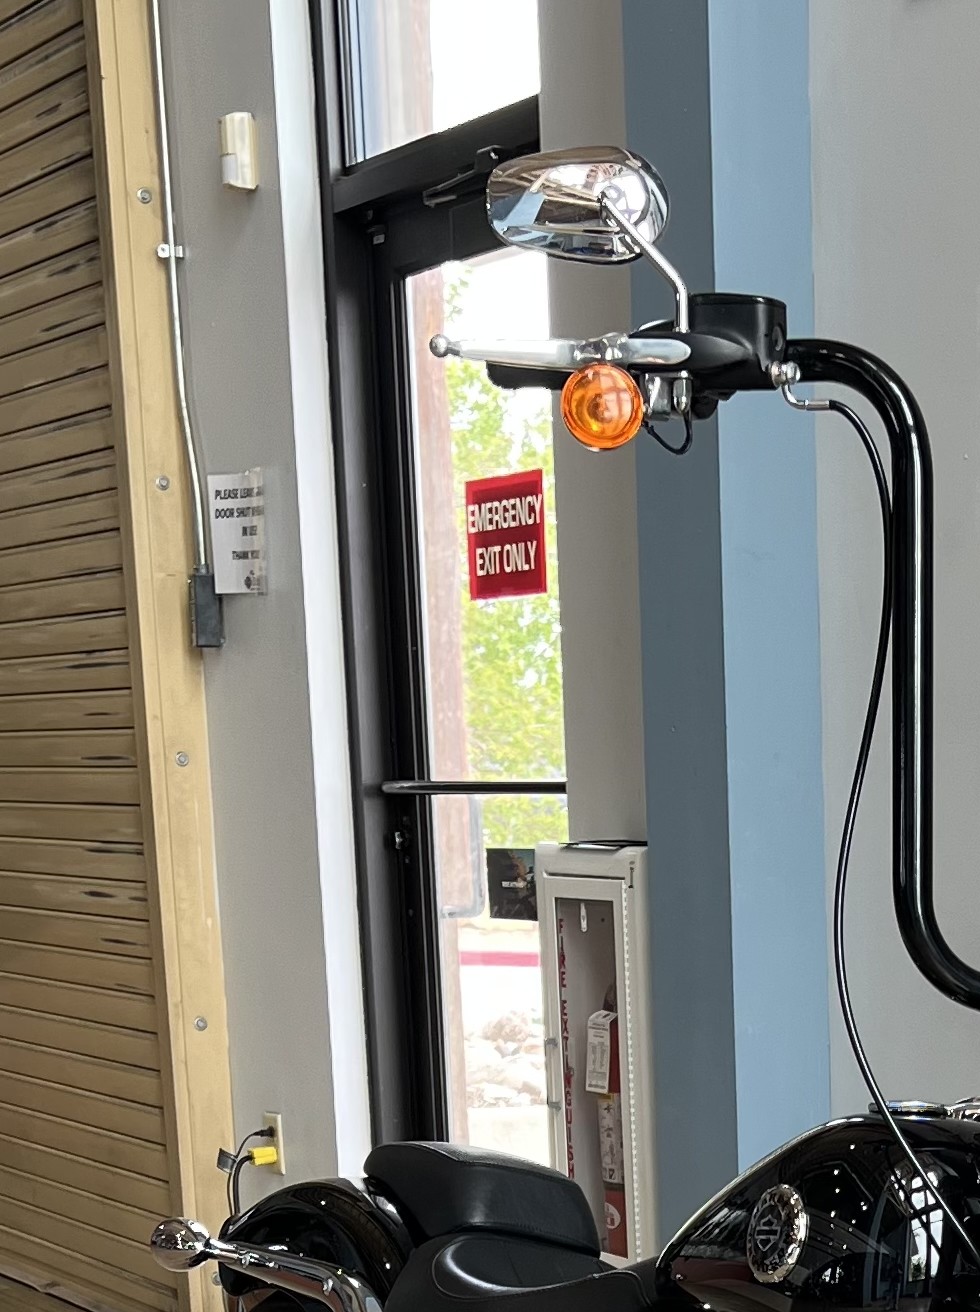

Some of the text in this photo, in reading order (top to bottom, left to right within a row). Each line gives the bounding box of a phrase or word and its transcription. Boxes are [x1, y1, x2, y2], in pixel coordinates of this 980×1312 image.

[214, 488, 239, 500] PLEASE
[467, 493, 542, 534] EMERGENCY
[475, 540, 537, 577] EXIT ONLY
